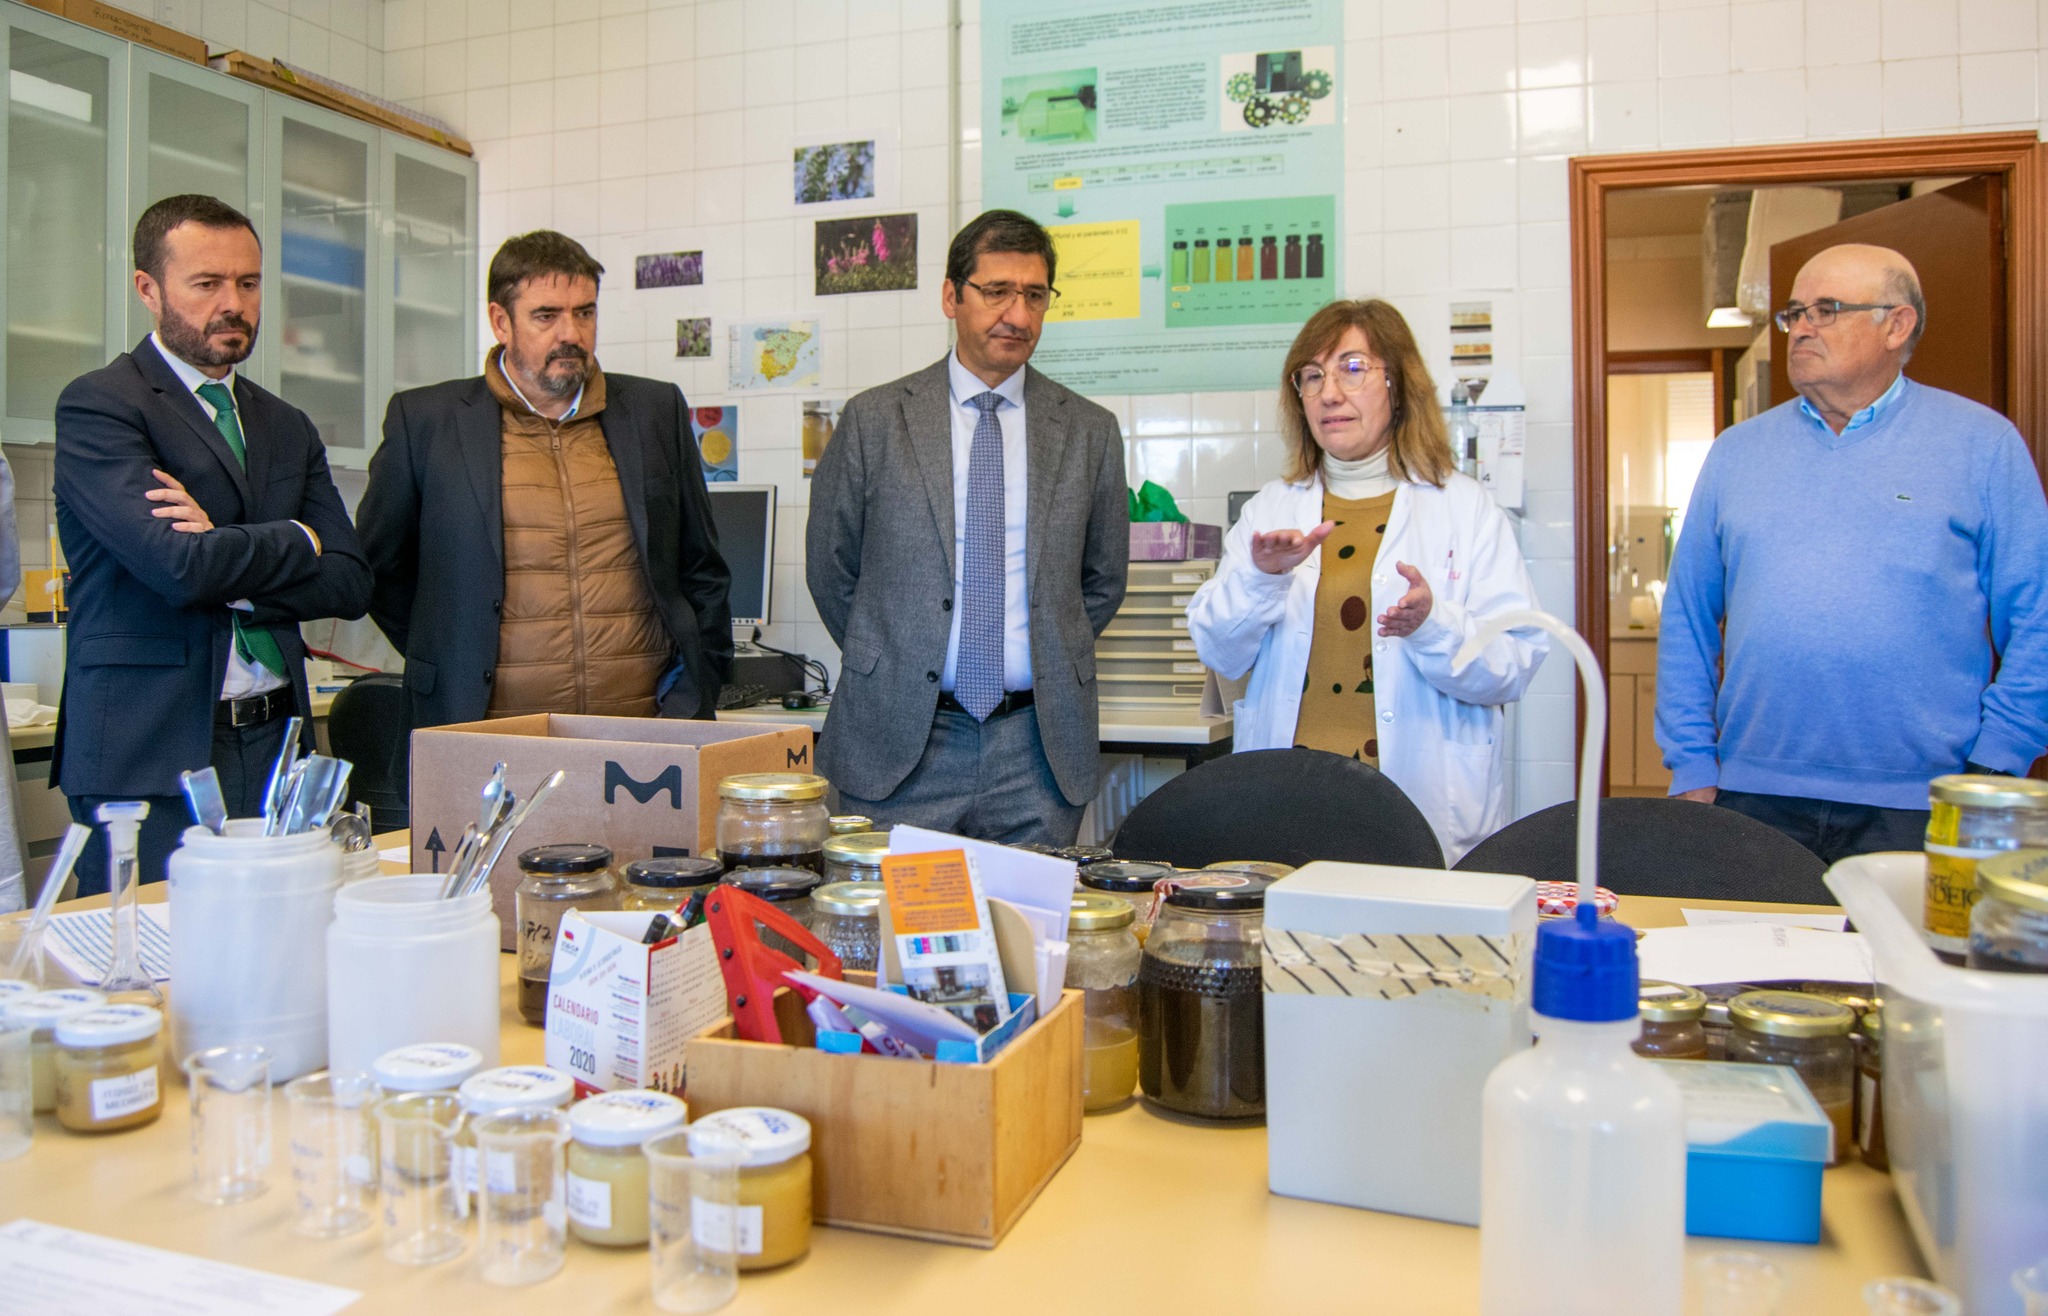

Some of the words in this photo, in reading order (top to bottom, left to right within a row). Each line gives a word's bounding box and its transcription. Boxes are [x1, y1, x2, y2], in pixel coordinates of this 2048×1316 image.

[604, 760, 682, 809] M
[553, 994, 599, 1026] CALENDARIO
[552, 1013, 597, 1052] LABORAL
[569, 1045, 596, 1076] 2020
